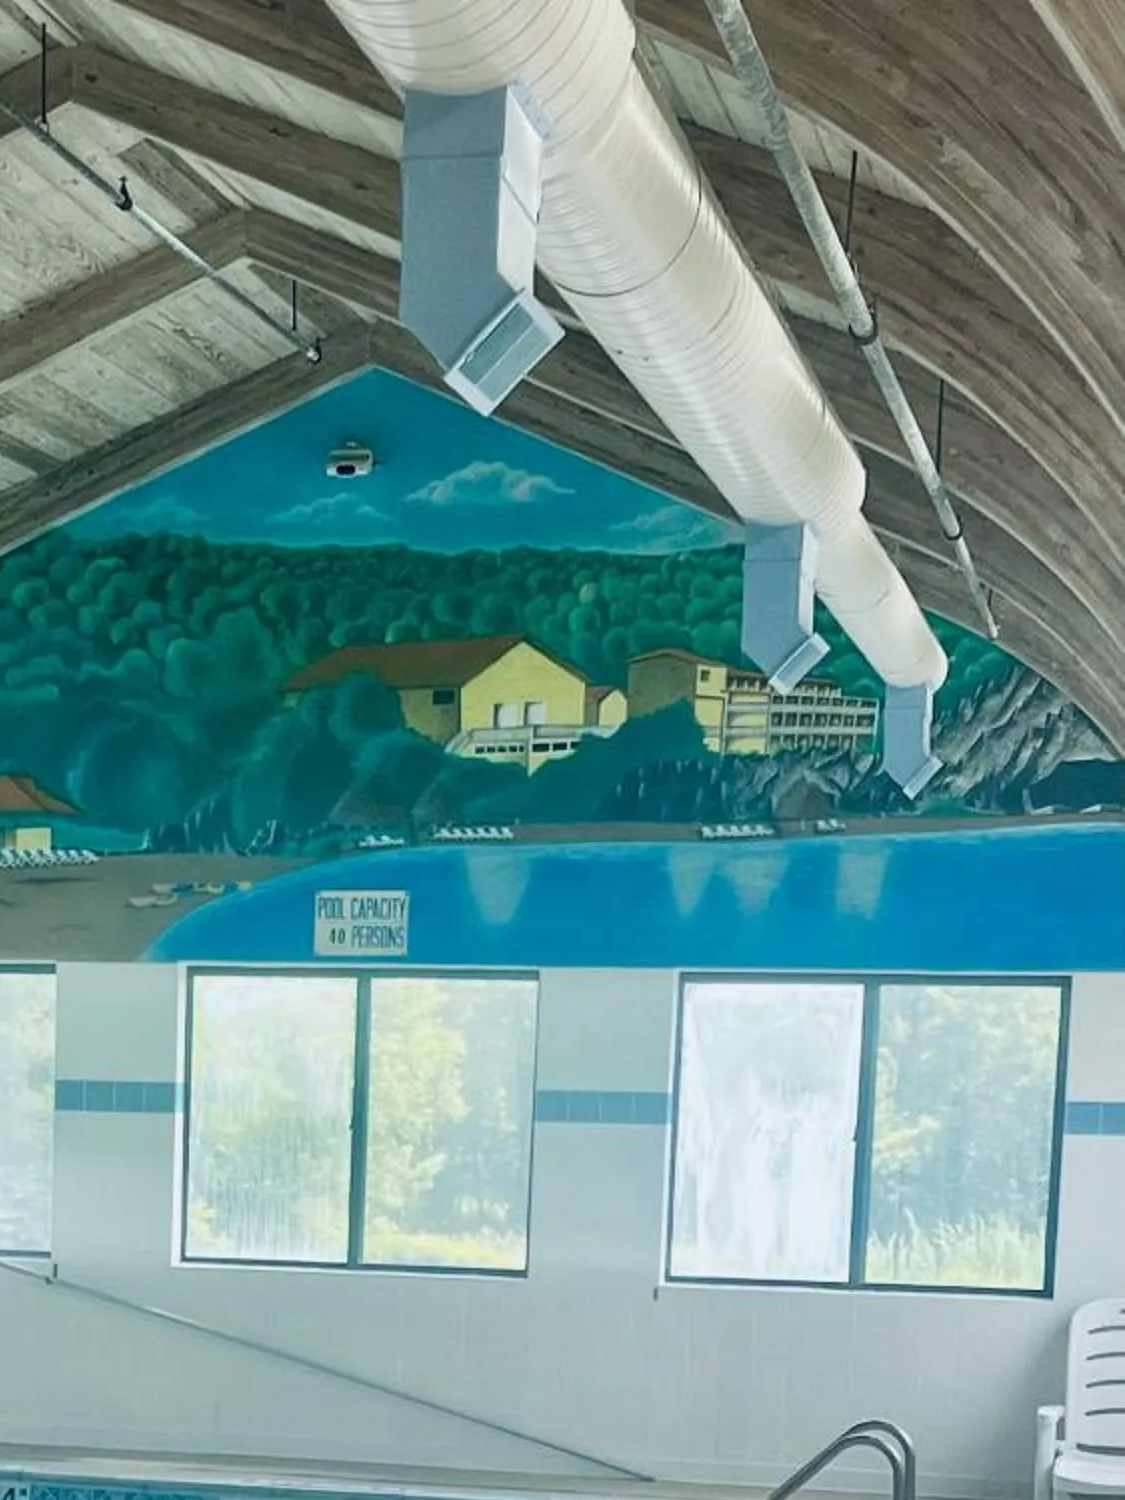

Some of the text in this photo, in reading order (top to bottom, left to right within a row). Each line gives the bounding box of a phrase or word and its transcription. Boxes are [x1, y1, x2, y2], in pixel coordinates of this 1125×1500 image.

[318, 896, 406, 920] POOL CAPACITY
[329, 925, 405, 949] 40 PERSONS
